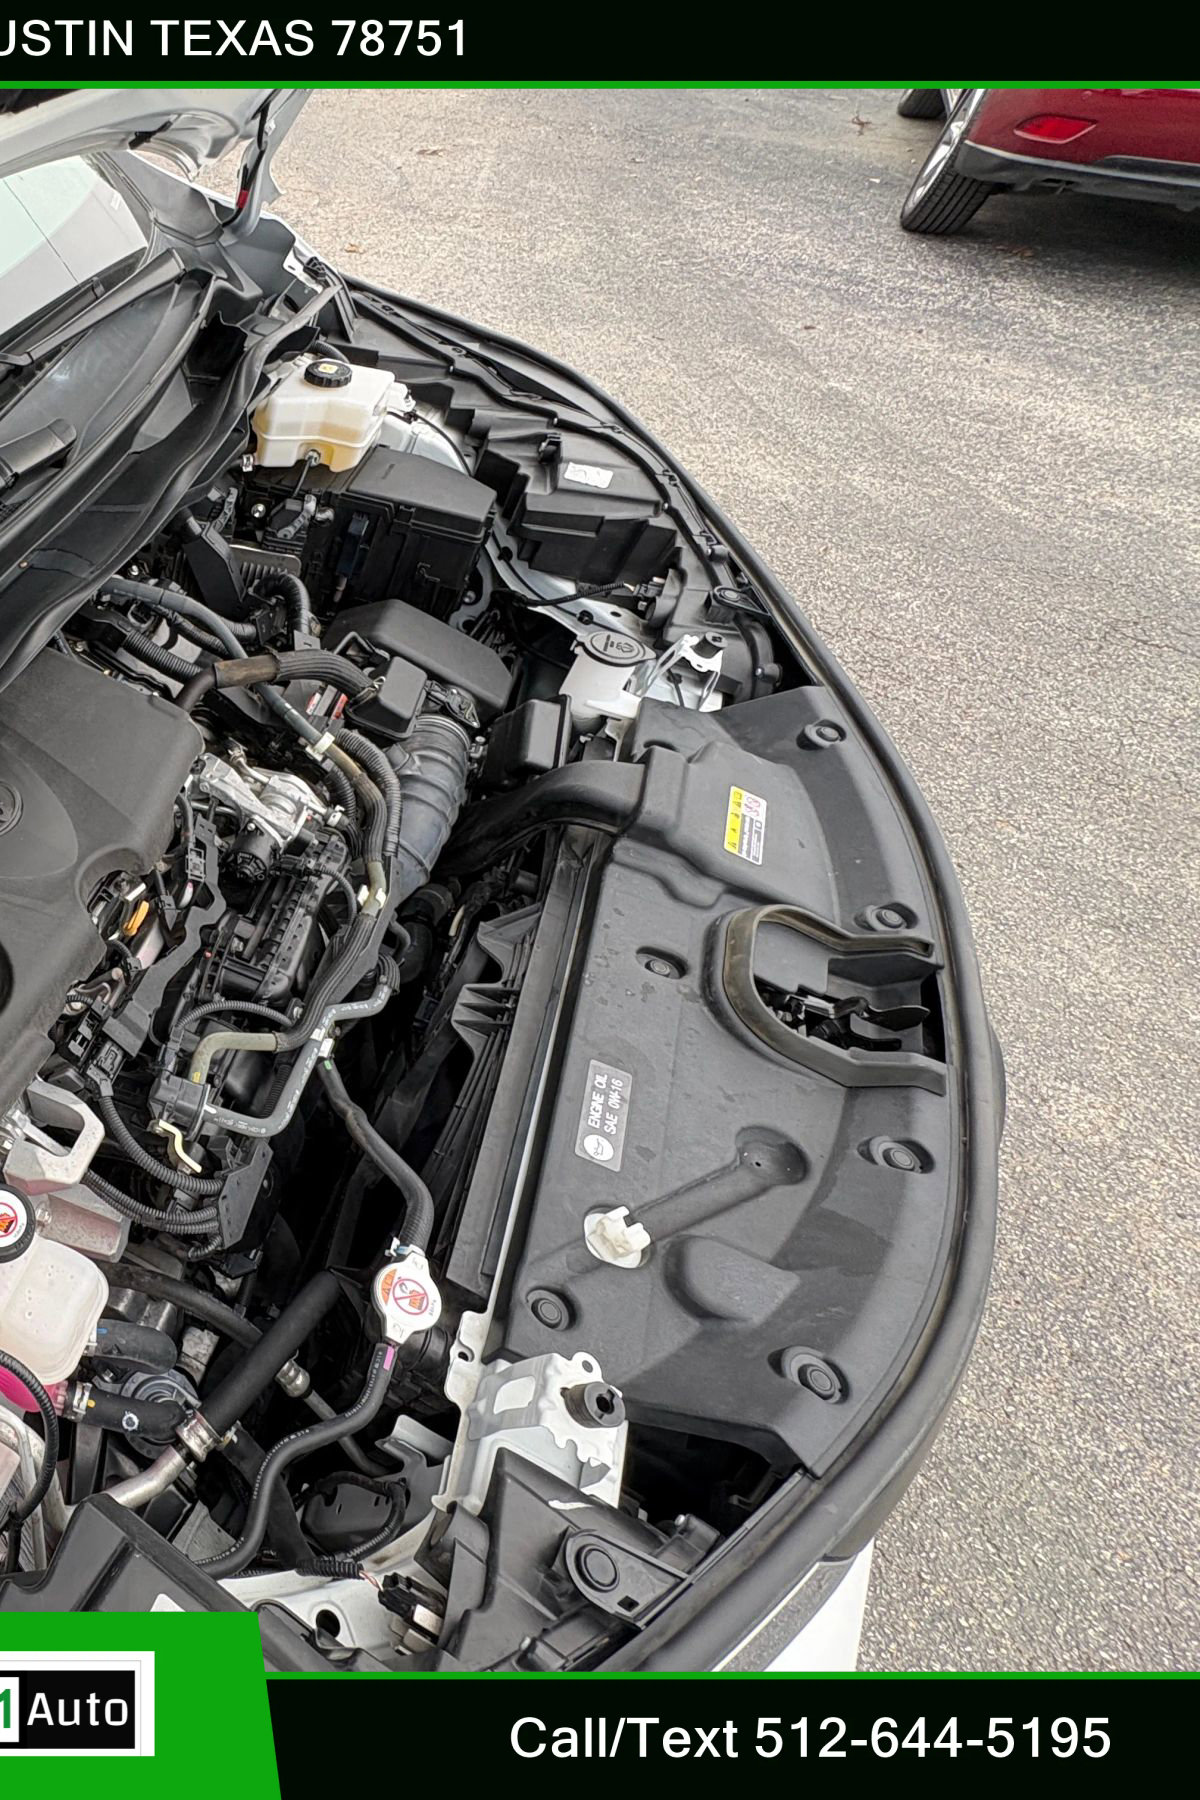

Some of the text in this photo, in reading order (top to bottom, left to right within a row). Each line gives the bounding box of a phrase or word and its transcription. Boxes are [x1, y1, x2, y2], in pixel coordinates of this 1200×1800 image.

[587, 1073, 608, 1129] ENGINE OIL
[603, 1111, 618, 1135] SAE
